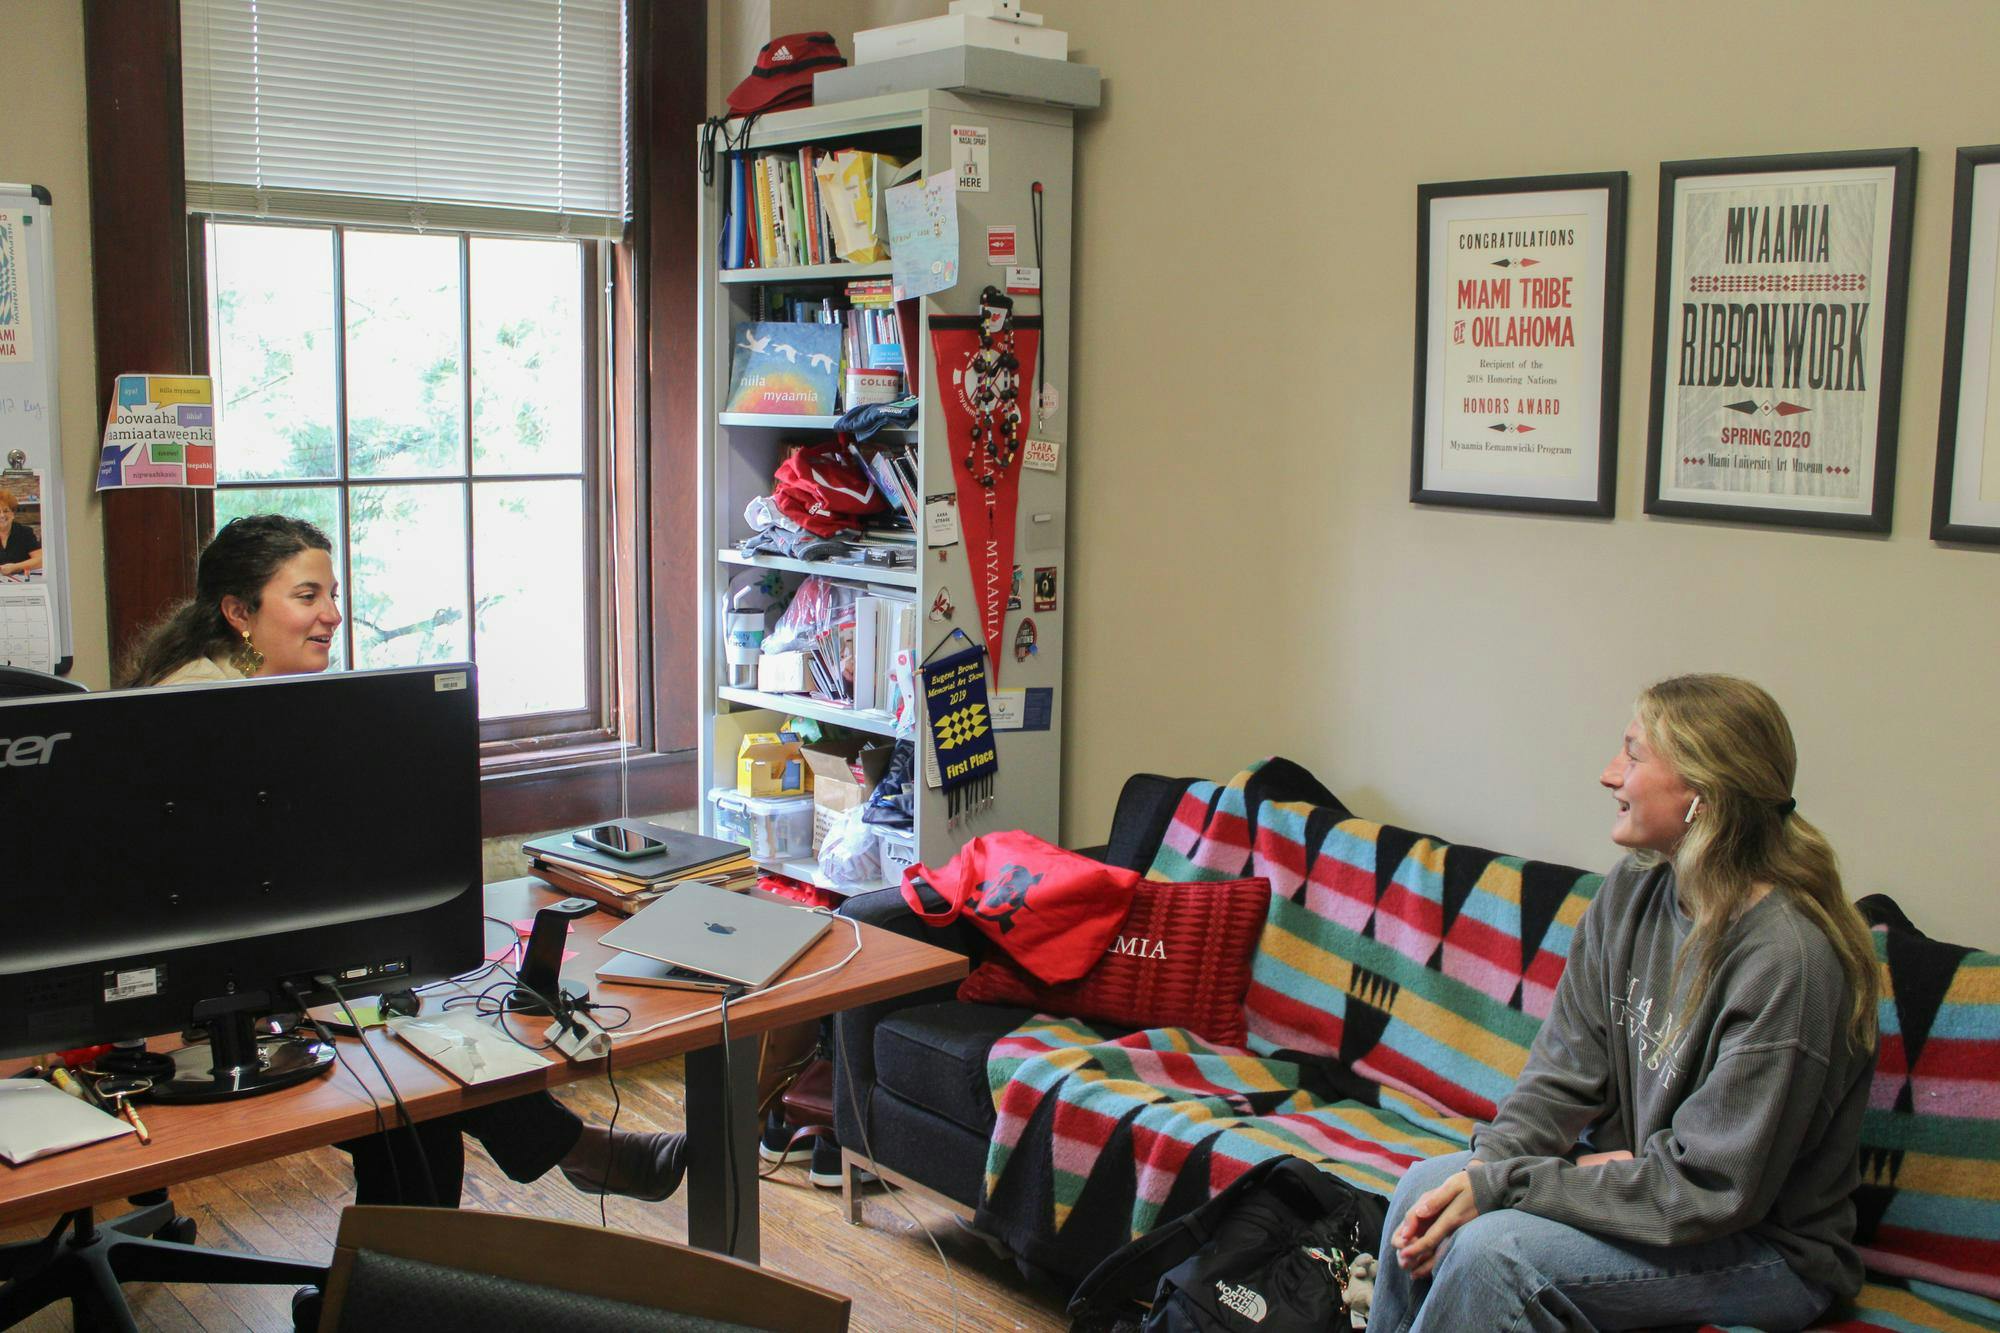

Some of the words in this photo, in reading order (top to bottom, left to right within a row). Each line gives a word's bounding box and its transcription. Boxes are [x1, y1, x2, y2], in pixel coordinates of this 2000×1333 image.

[771, 54, 793, 62] adidas
[960, 177, 982, 188] HERE
[1459, 229, 1574, 250] CONGRATULATIONS
[1725, 204, 1829, 264] MYAAMIA
[1457, 278, 1511, 309] MIAMI
[1519, 277, 1573, 309] TRIBE
[1472, 316, 1575, 347] OKLAHOMA
[1480, 359, 1515, 370] Recipient
[1518, 360, 1527, 369] of
[1531, 360, 1543, 369] the
[741, 374, 766, 386] niila
[1466, 375, 1483, 384] 2018
[1487, 375, 1522, 385] Honoring
[1527, 376, 1557, 385] Nations
[763, 391, 818, 403] myaamia
[1463, 397, 1509, 414] HONORS
[1518, 398, 1560, 415] AWARD
[117, 411, 177, 425] oowaaha
[1721, 427, 1771, 446] SPRING
[1774, 430, 1811, 448] 2020
[1031, 442, 1052, 452] KARA
[1450, 440, 1483, 451] Myaamia
[1537, 444, 1572, 455] Program
[1025, 451, 1056, 462] STRASS
[1708, 453, 1730, 468] Miami
[1734, 455, 1770, 473] University
[1776, 457, 1787, 472] Art
[1792, 458, 1823, 474] Museum
[986, 539, 999, 641] MYAAMIA
[931, 670, 955, 685] Eugene
[957, 662, 978, 675] Brown
[928, 681, 955, 698] Memorial
[957, 677, 966, 687] Art
[968, 671, 984, 683] Show
[949, 690, 967, 706] 2019
[946, 760, 968, 779] First
[970, 749, 994, 768] Place
[1107, 935, 1168, 960] MIA
[1215, 1279, 1252, 1306] NORTH
[1237, 1284, 1257, 1300] THE
[1218, 1295, 1248, 1314] FACE
